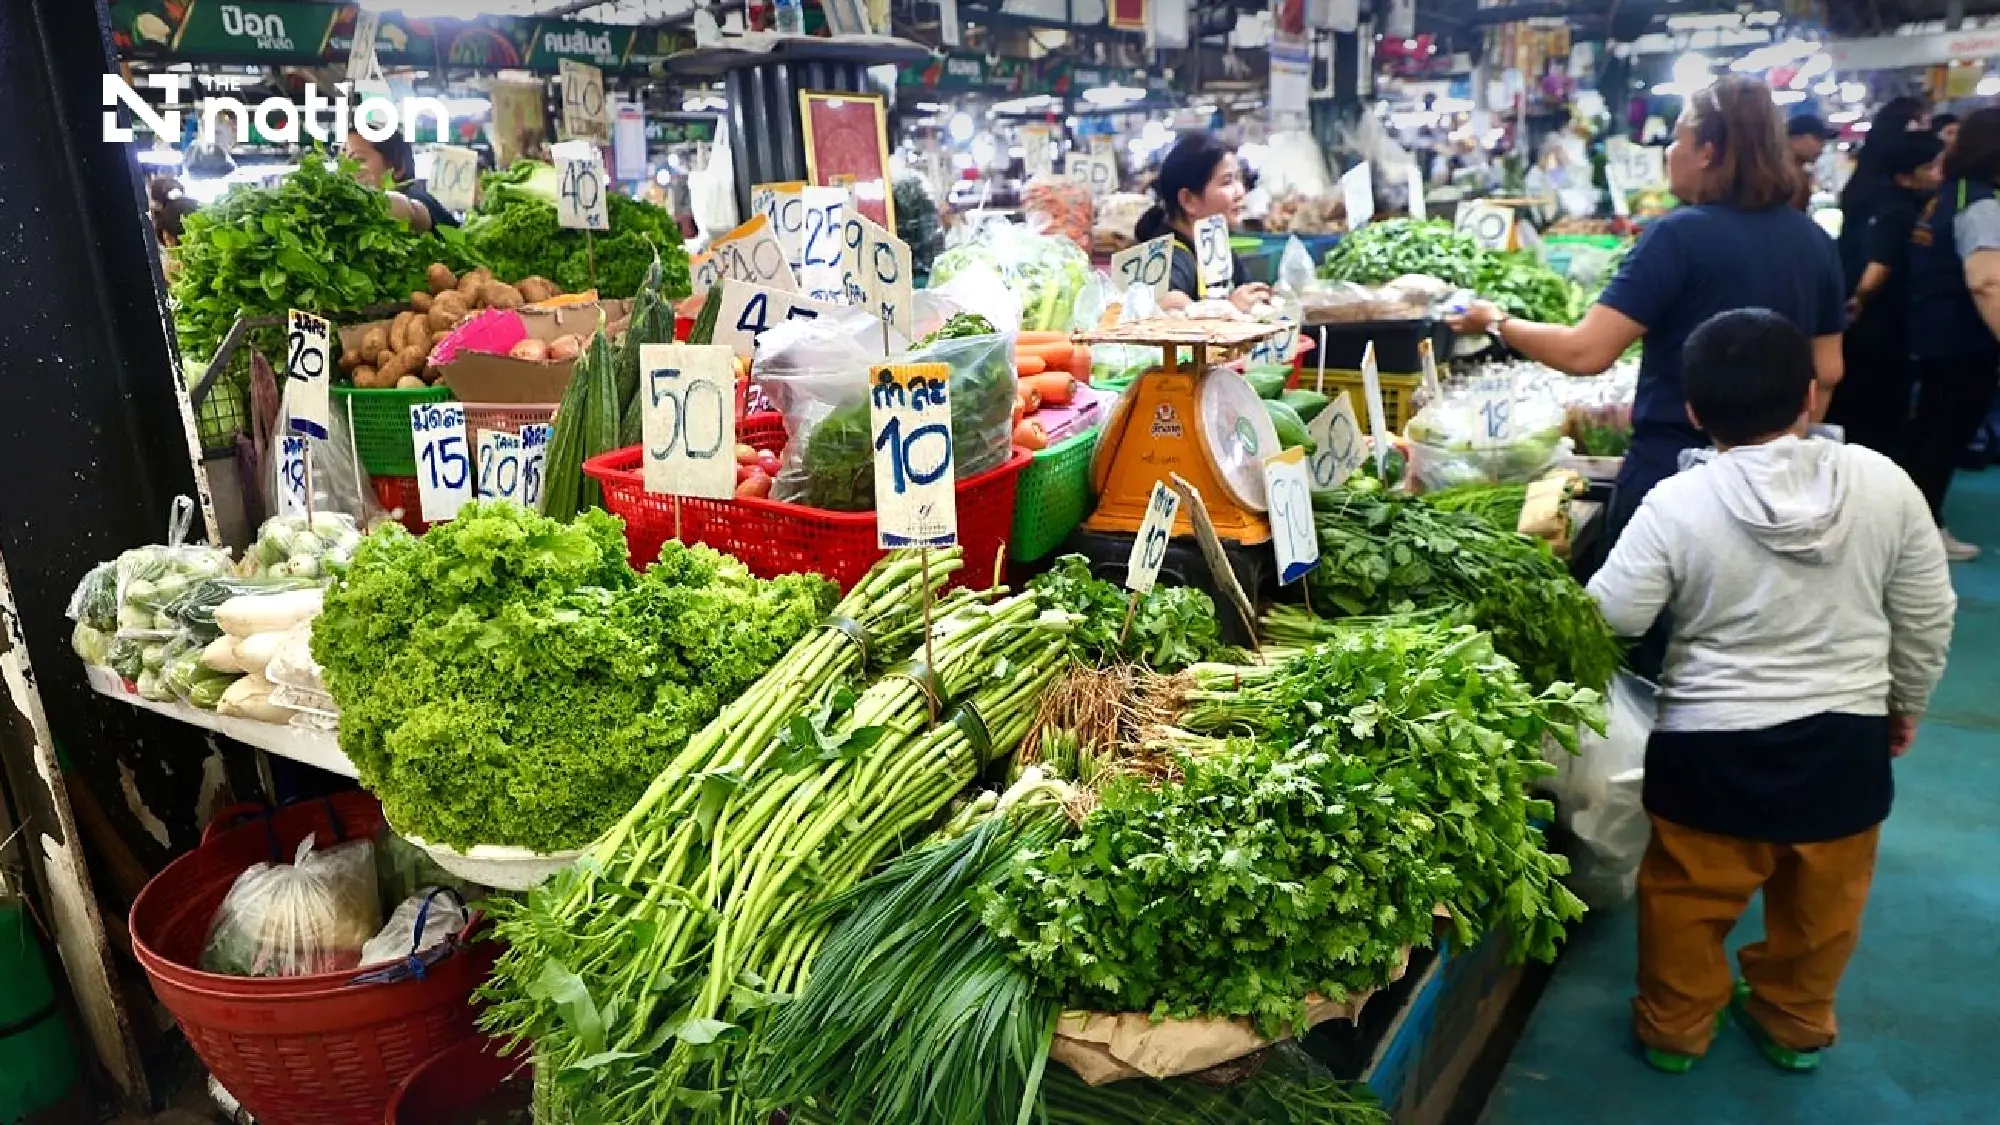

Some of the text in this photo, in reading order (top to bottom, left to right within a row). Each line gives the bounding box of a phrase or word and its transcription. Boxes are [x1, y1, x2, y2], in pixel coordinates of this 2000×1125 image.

[562, 161, 599, 215] 40
[846, 219, 899, 284] 90
[736, 292, 818, 347] 4
[288, 331, 324, 382] 20
[650, 368, 723, 460] 50
[422, 436, 467, 489] 15
[477, 444, 519, 497] 20
[876, 416, 951, 494] 10
